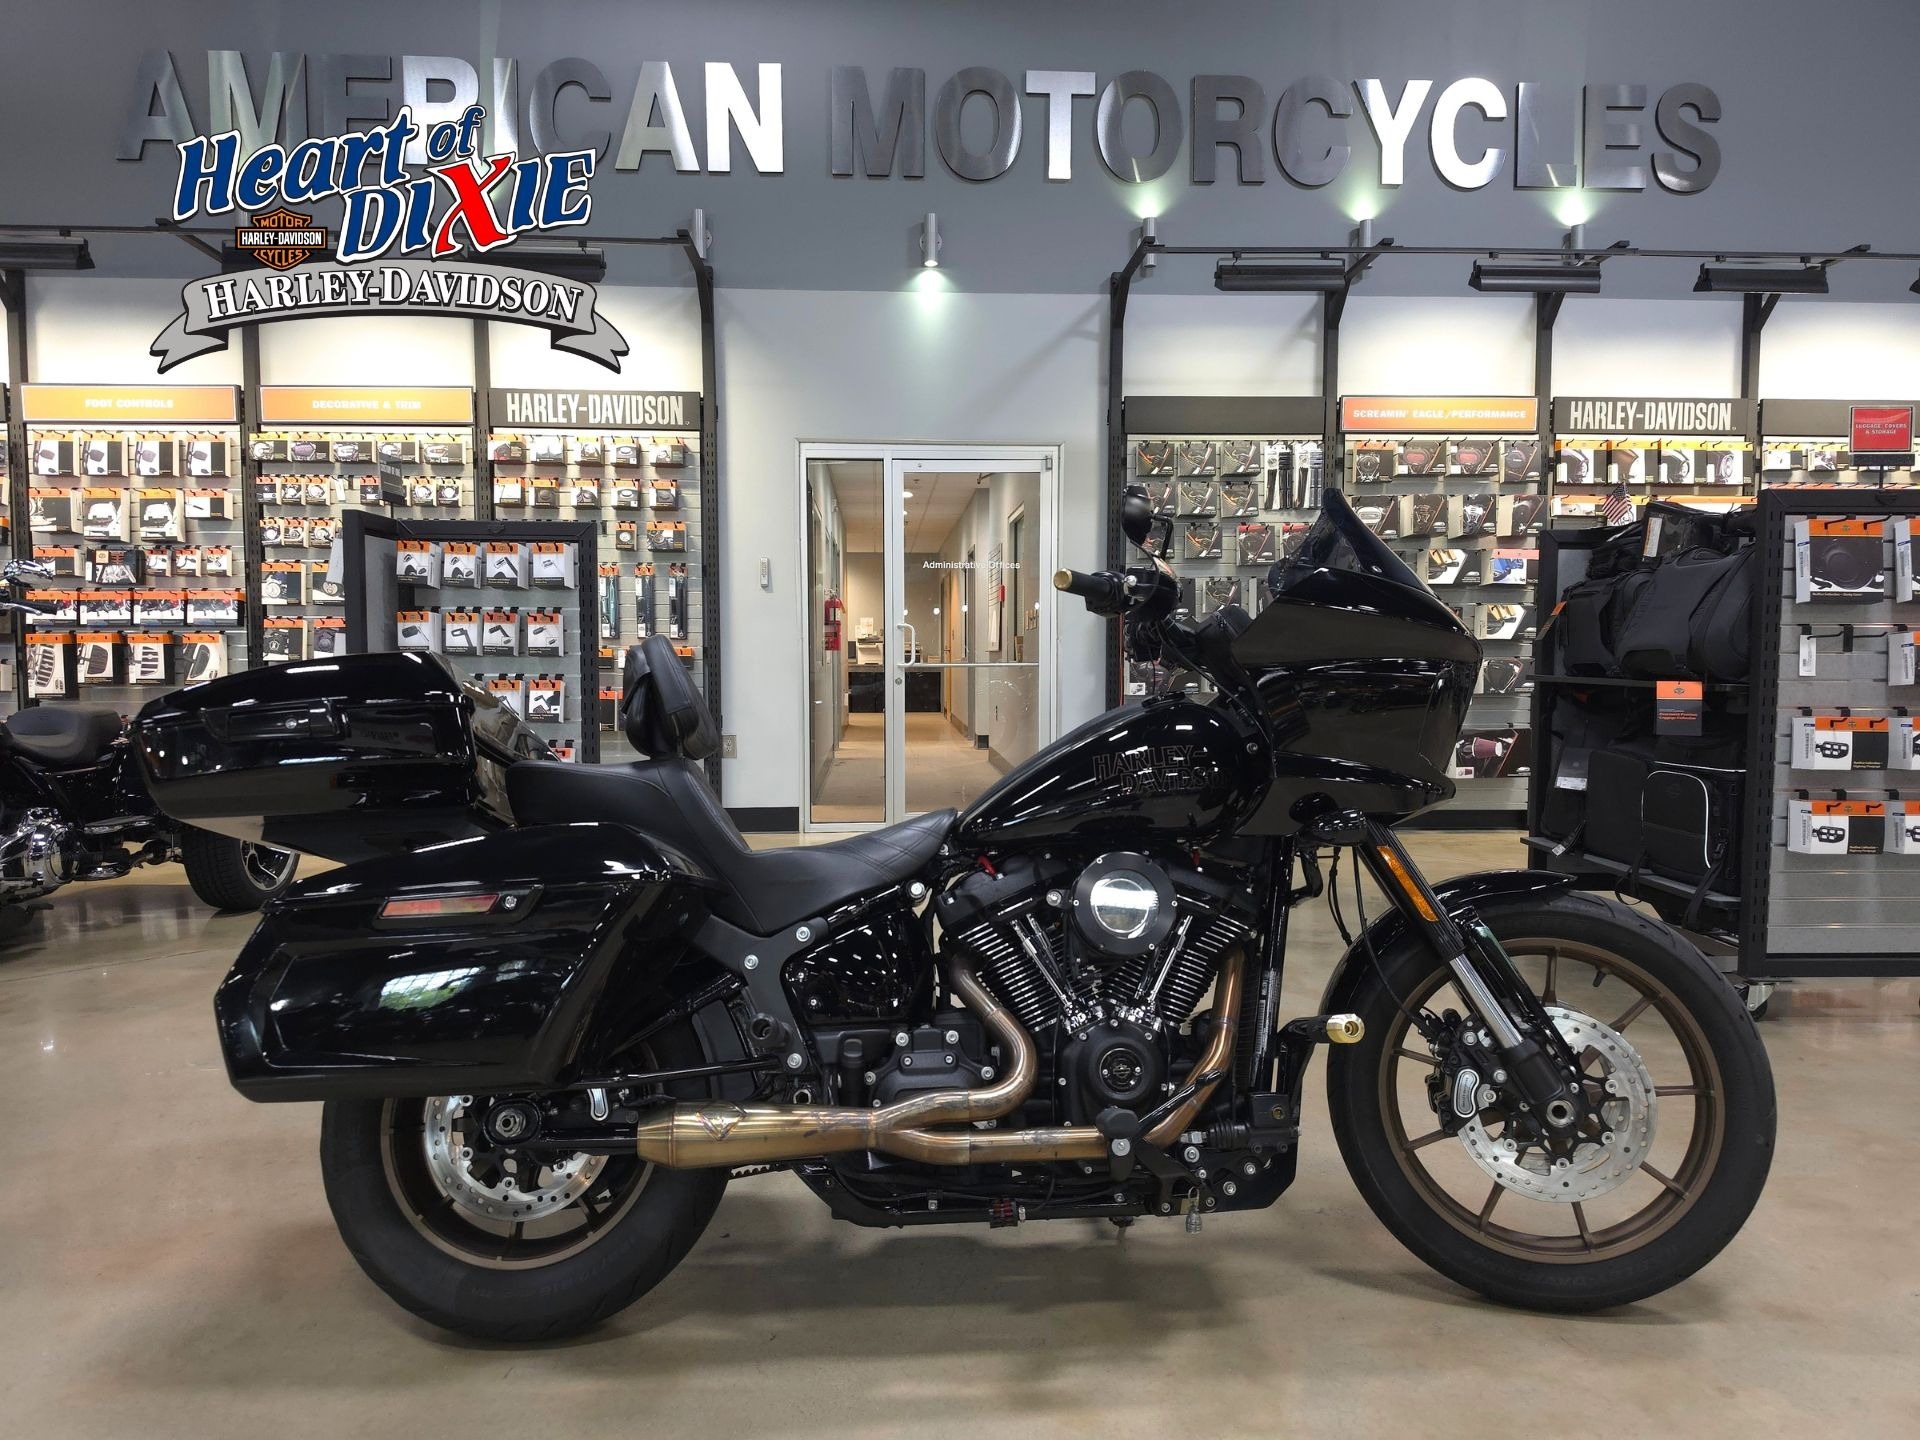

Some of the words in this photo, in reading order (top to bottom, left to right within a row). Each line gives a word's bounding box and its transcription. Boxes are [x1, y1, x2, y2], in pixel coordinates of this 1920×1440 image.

[116, 50, 784, 173] AMERICAN
[831, 66, 1722, 195] MOTORCYCLES
[85, 399, 112, 409] FOOT
[116, 399, 174, 409] CONTROLS
[312, 400, 379, 409] DECORATIVE
[395, 400, 421, 409] TRIM
[506, 392, 684, 426] HARLEY-DAVIDSON
[1353, 409, 1408, 419] SCREAMIN'
[1570, 401, 1733, 431] HARLEY-DAVIDSON
[922, 560, 987, 569] Administrative
[988, 561, 1021, 569] Offices
